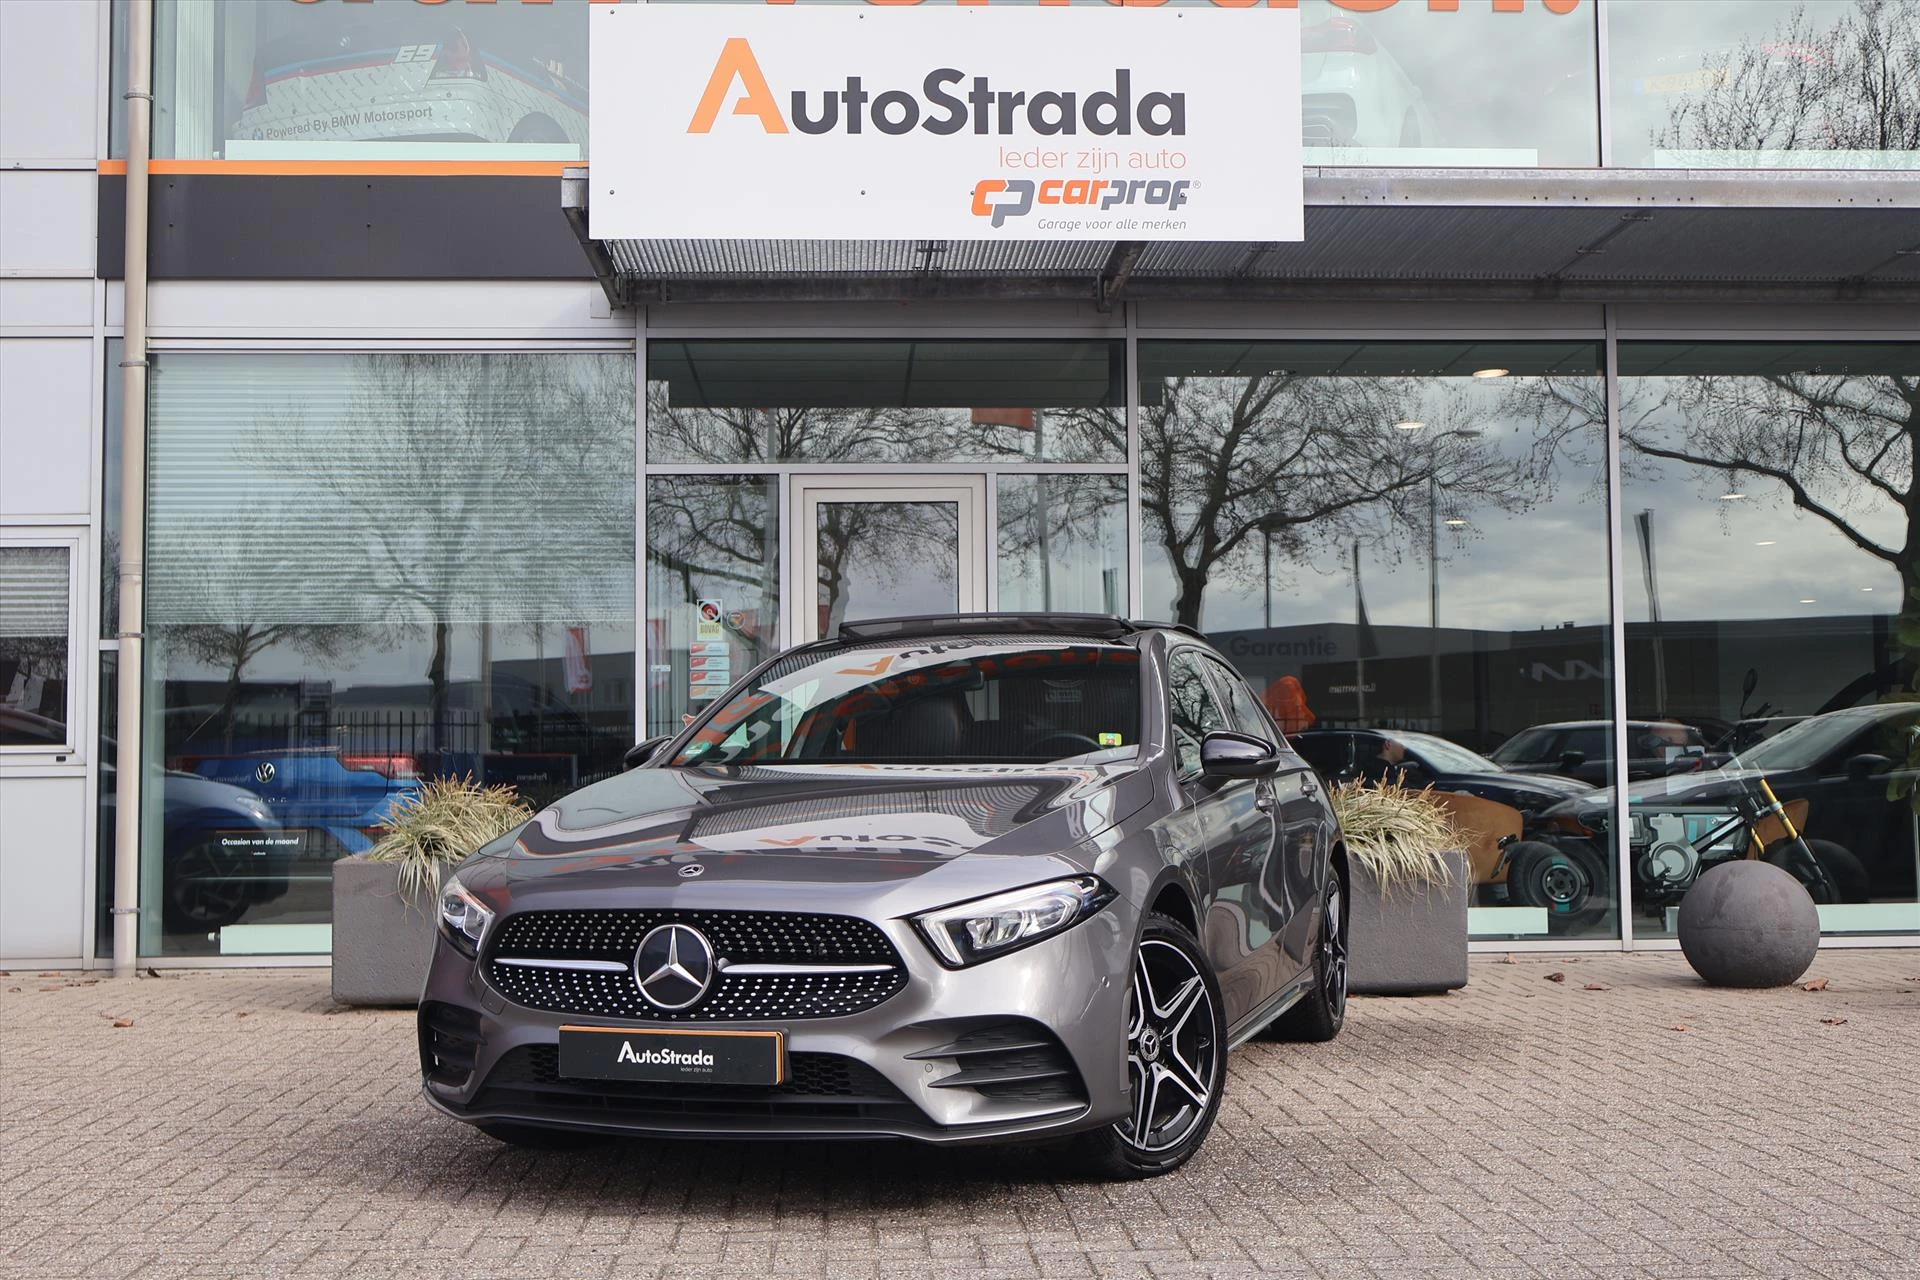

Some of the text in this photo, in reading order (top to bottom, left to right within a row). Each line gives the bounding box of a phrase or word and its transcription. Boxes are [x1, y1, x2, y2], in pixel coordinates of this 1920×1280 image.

[687, 38, 1186, 136] AutoStrada
[266, 106, 433, 138] Powered By BMW Motorsport
[1077, 147, 1119, 174] zijn
[1128, 149, 1187, 169] auto
[1038, 218, 1187, 232] Garage voor alle merken
[1229, 635, 1337, 657] Garantie
[617, 1040, 714, 1066] AutoStrada
